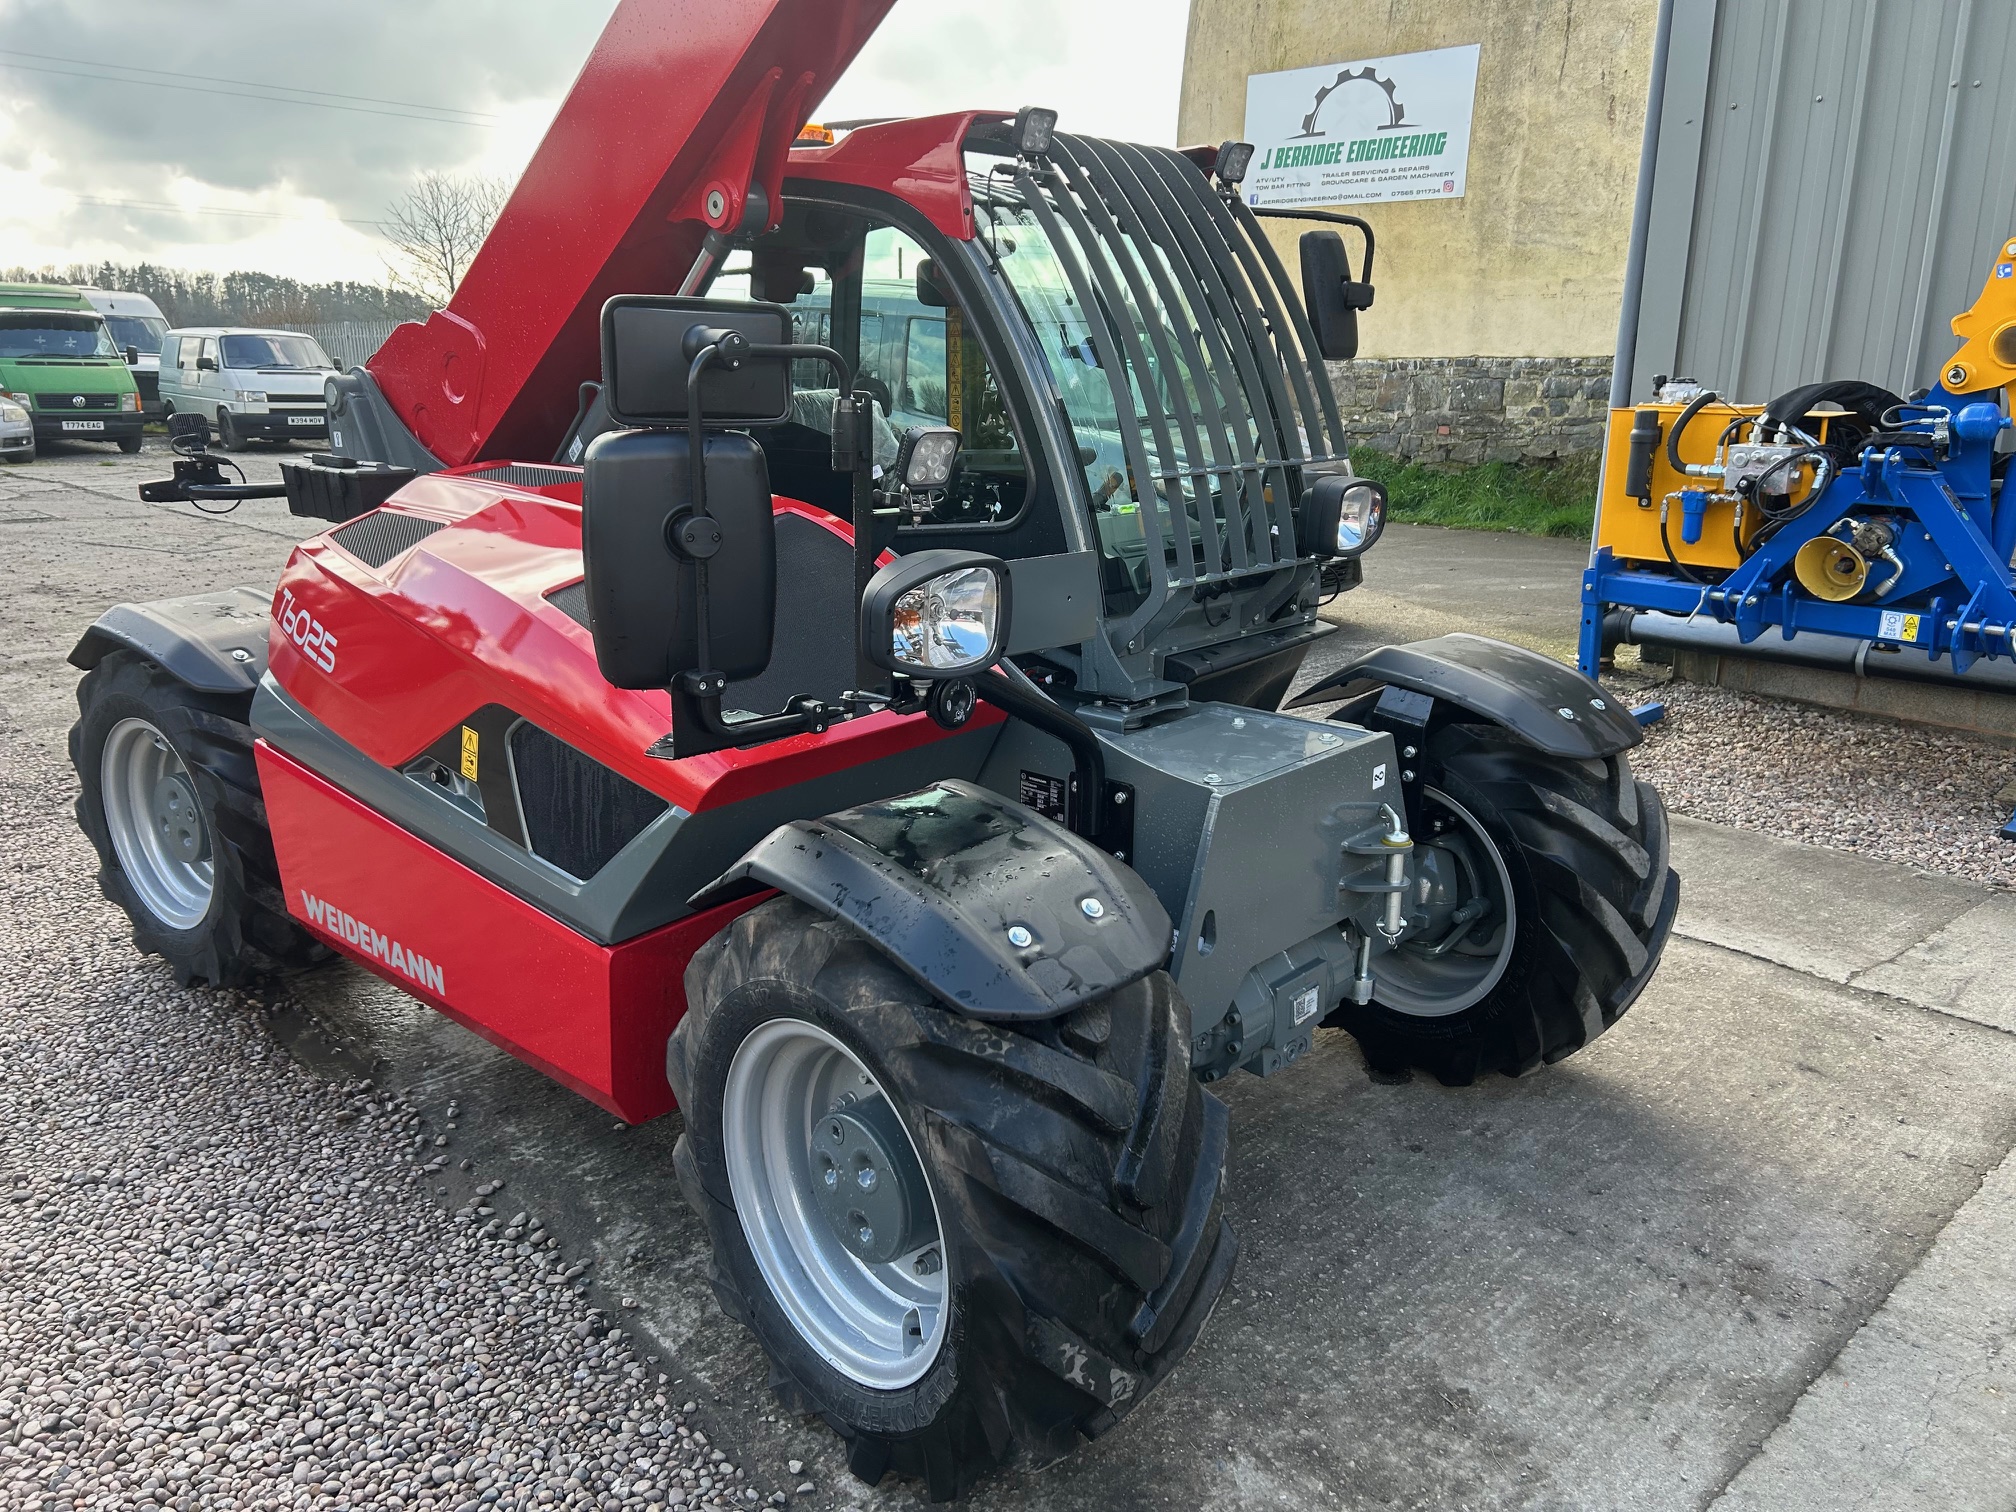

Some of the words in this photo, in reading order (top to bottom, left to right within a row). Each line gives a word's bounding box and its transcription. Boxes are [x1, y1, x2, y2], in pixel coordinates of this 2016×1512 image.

[1260, 148, 1272, 170] J
[1273, 141, 1345, 169] BERRIDGE
[1346, 132, 1448, 163] ENGINEERING
[1321, 177, 1369, 186] GROUNDCARE
[1409, 171, 1455, 180] MACHINERY
[1322, 171, 1350, 179] TRAILER
[1352, 168, 1389, 177] SERVICING
[1398, 165, 1430, 173] REPAIRS
[278, 587, 338, 674] T6025
[301, 889, 446, 996] WEIDEMANN
